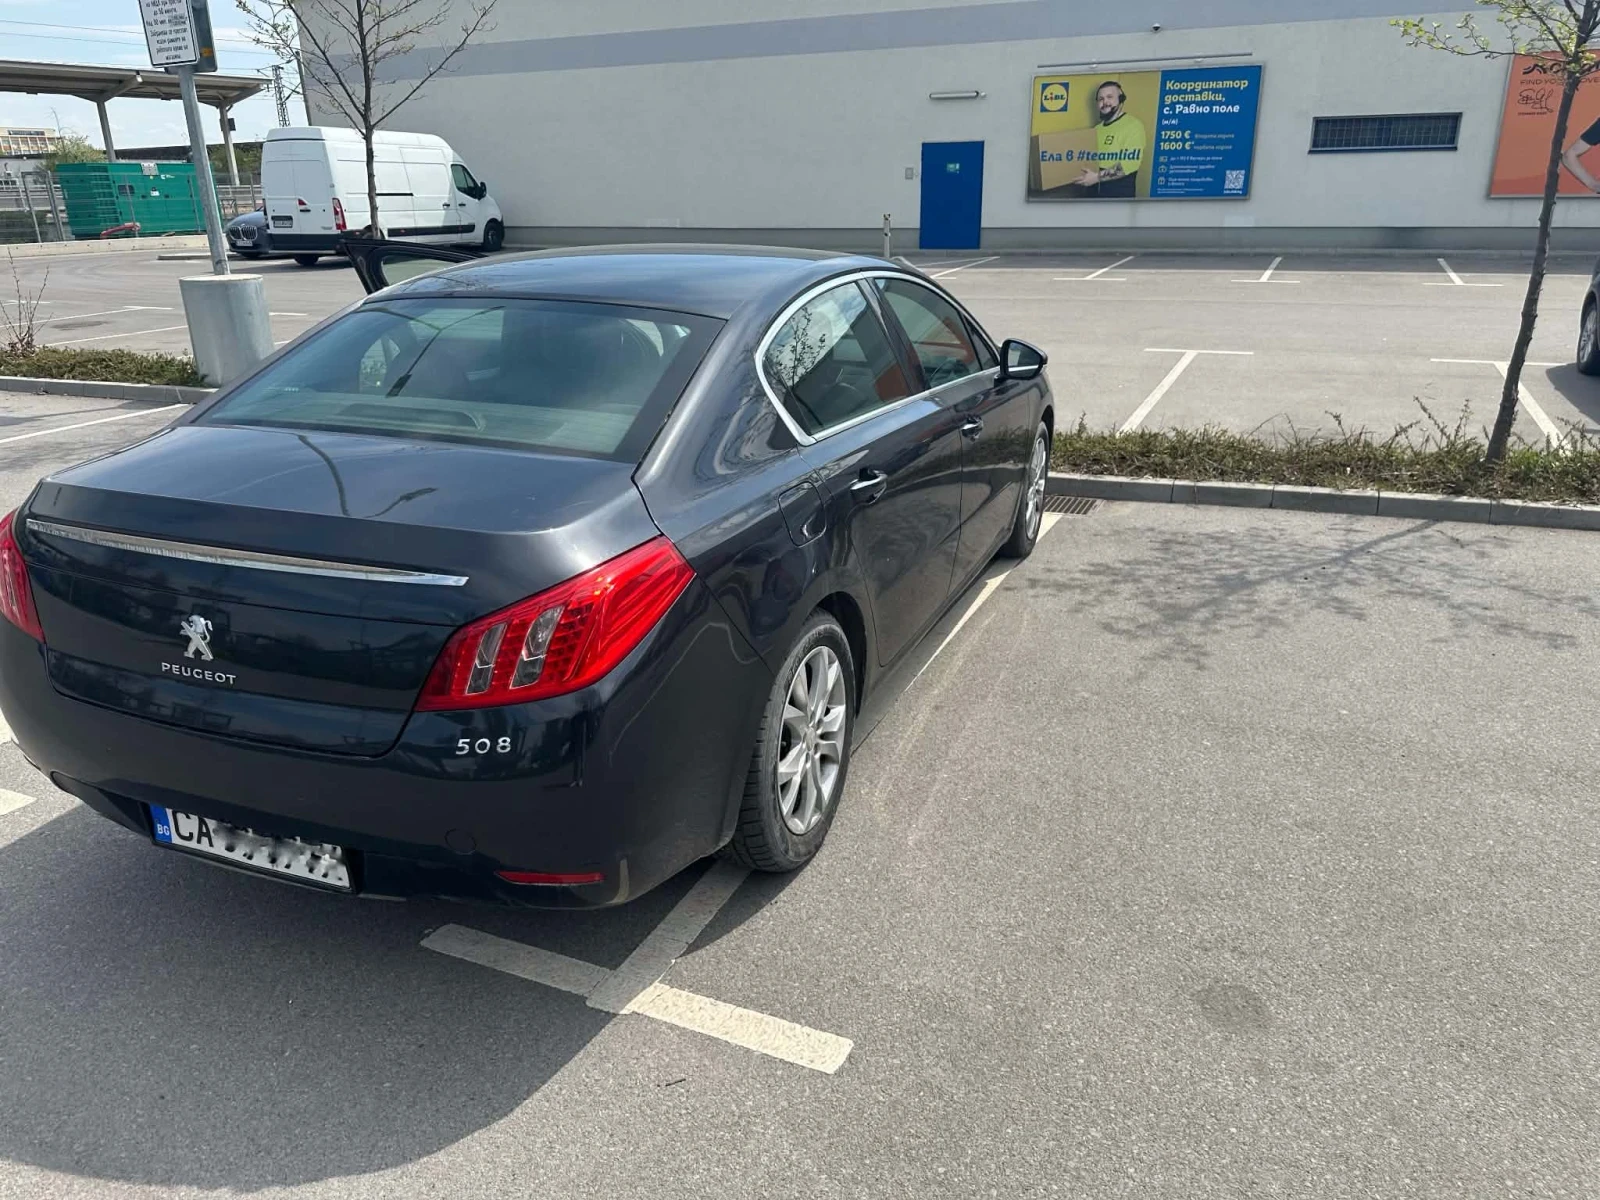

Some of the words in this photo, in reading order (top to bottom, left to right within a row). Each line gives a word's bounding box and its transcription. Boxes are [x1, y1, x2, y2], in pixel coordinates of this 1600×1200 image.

[1166, 79, 1249, 92] Координатор
[1164, 91, 1226, 104] доставки,
[1175, 103, 1210, 114] Равно
[1212, 105, 1240, 113] поле
[1160, 130, 1182, 139] 1750
[1184, 130, 1192, 139] €
[1160, 142, 1182, 150] 1600
[1040, 150, 1063, 162] Ела
[1077, 148, 1141, 162] #teamlidl
[160, 661, 237, 685] PEUGEOT
[455, 736, 513, 756] 508
[156, 822, 170, 837] BG
